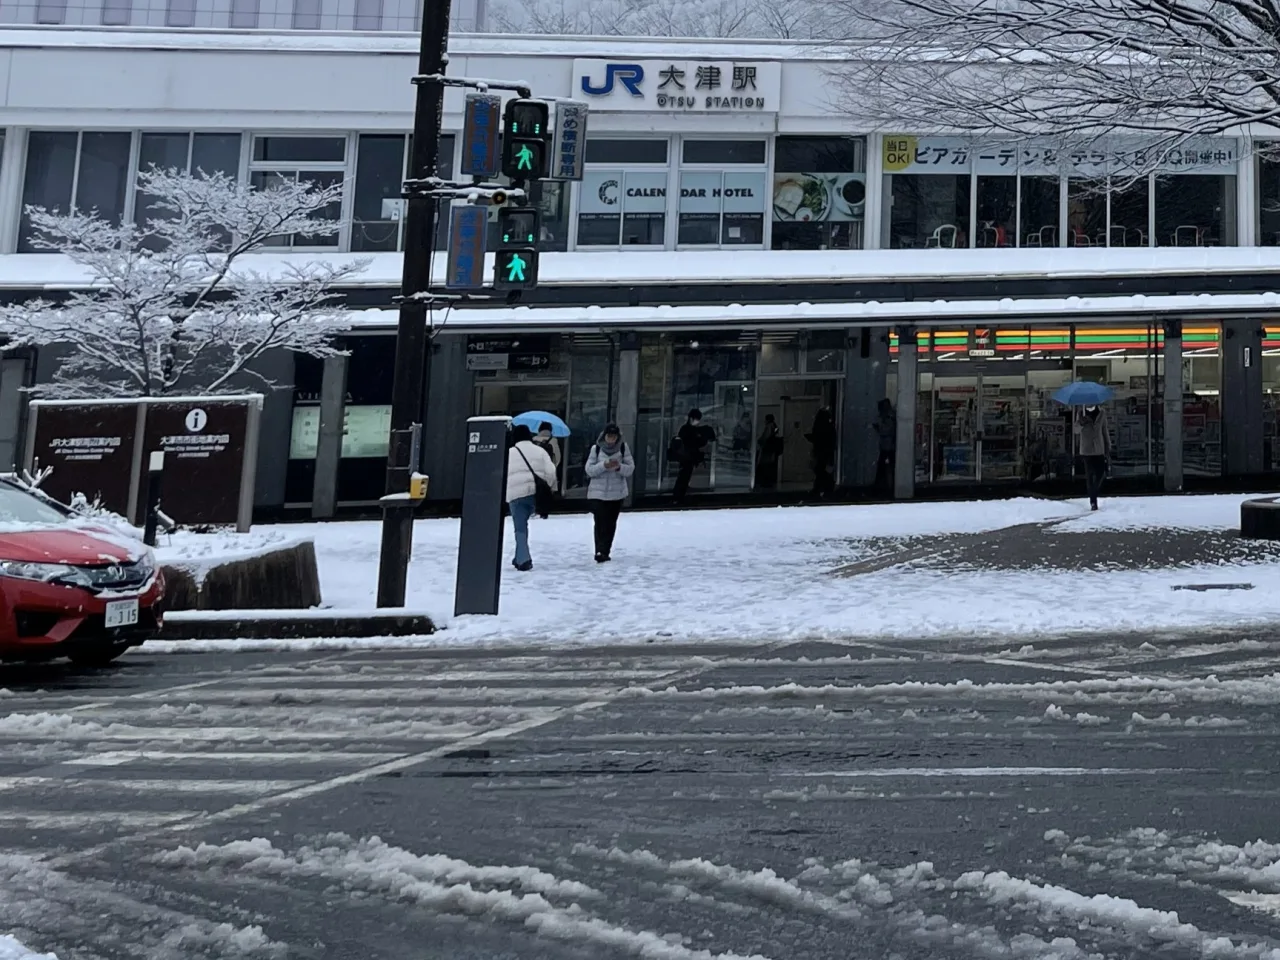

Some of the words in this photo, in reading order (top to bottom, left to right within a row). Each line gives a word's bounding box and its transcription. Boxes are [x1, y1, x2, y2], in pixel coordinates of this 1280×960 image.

[581, 64, 645, 97] JR
[657, 65, 758, 90] 大津駅
[705, 96, 765, 109] STATION
[887, 141, 908, 152] 当日
[886, 152, 910, 164] OK!
[626, 187, 706, 198] CALENDAR
[712, 188, 754, 198] HOTEL
